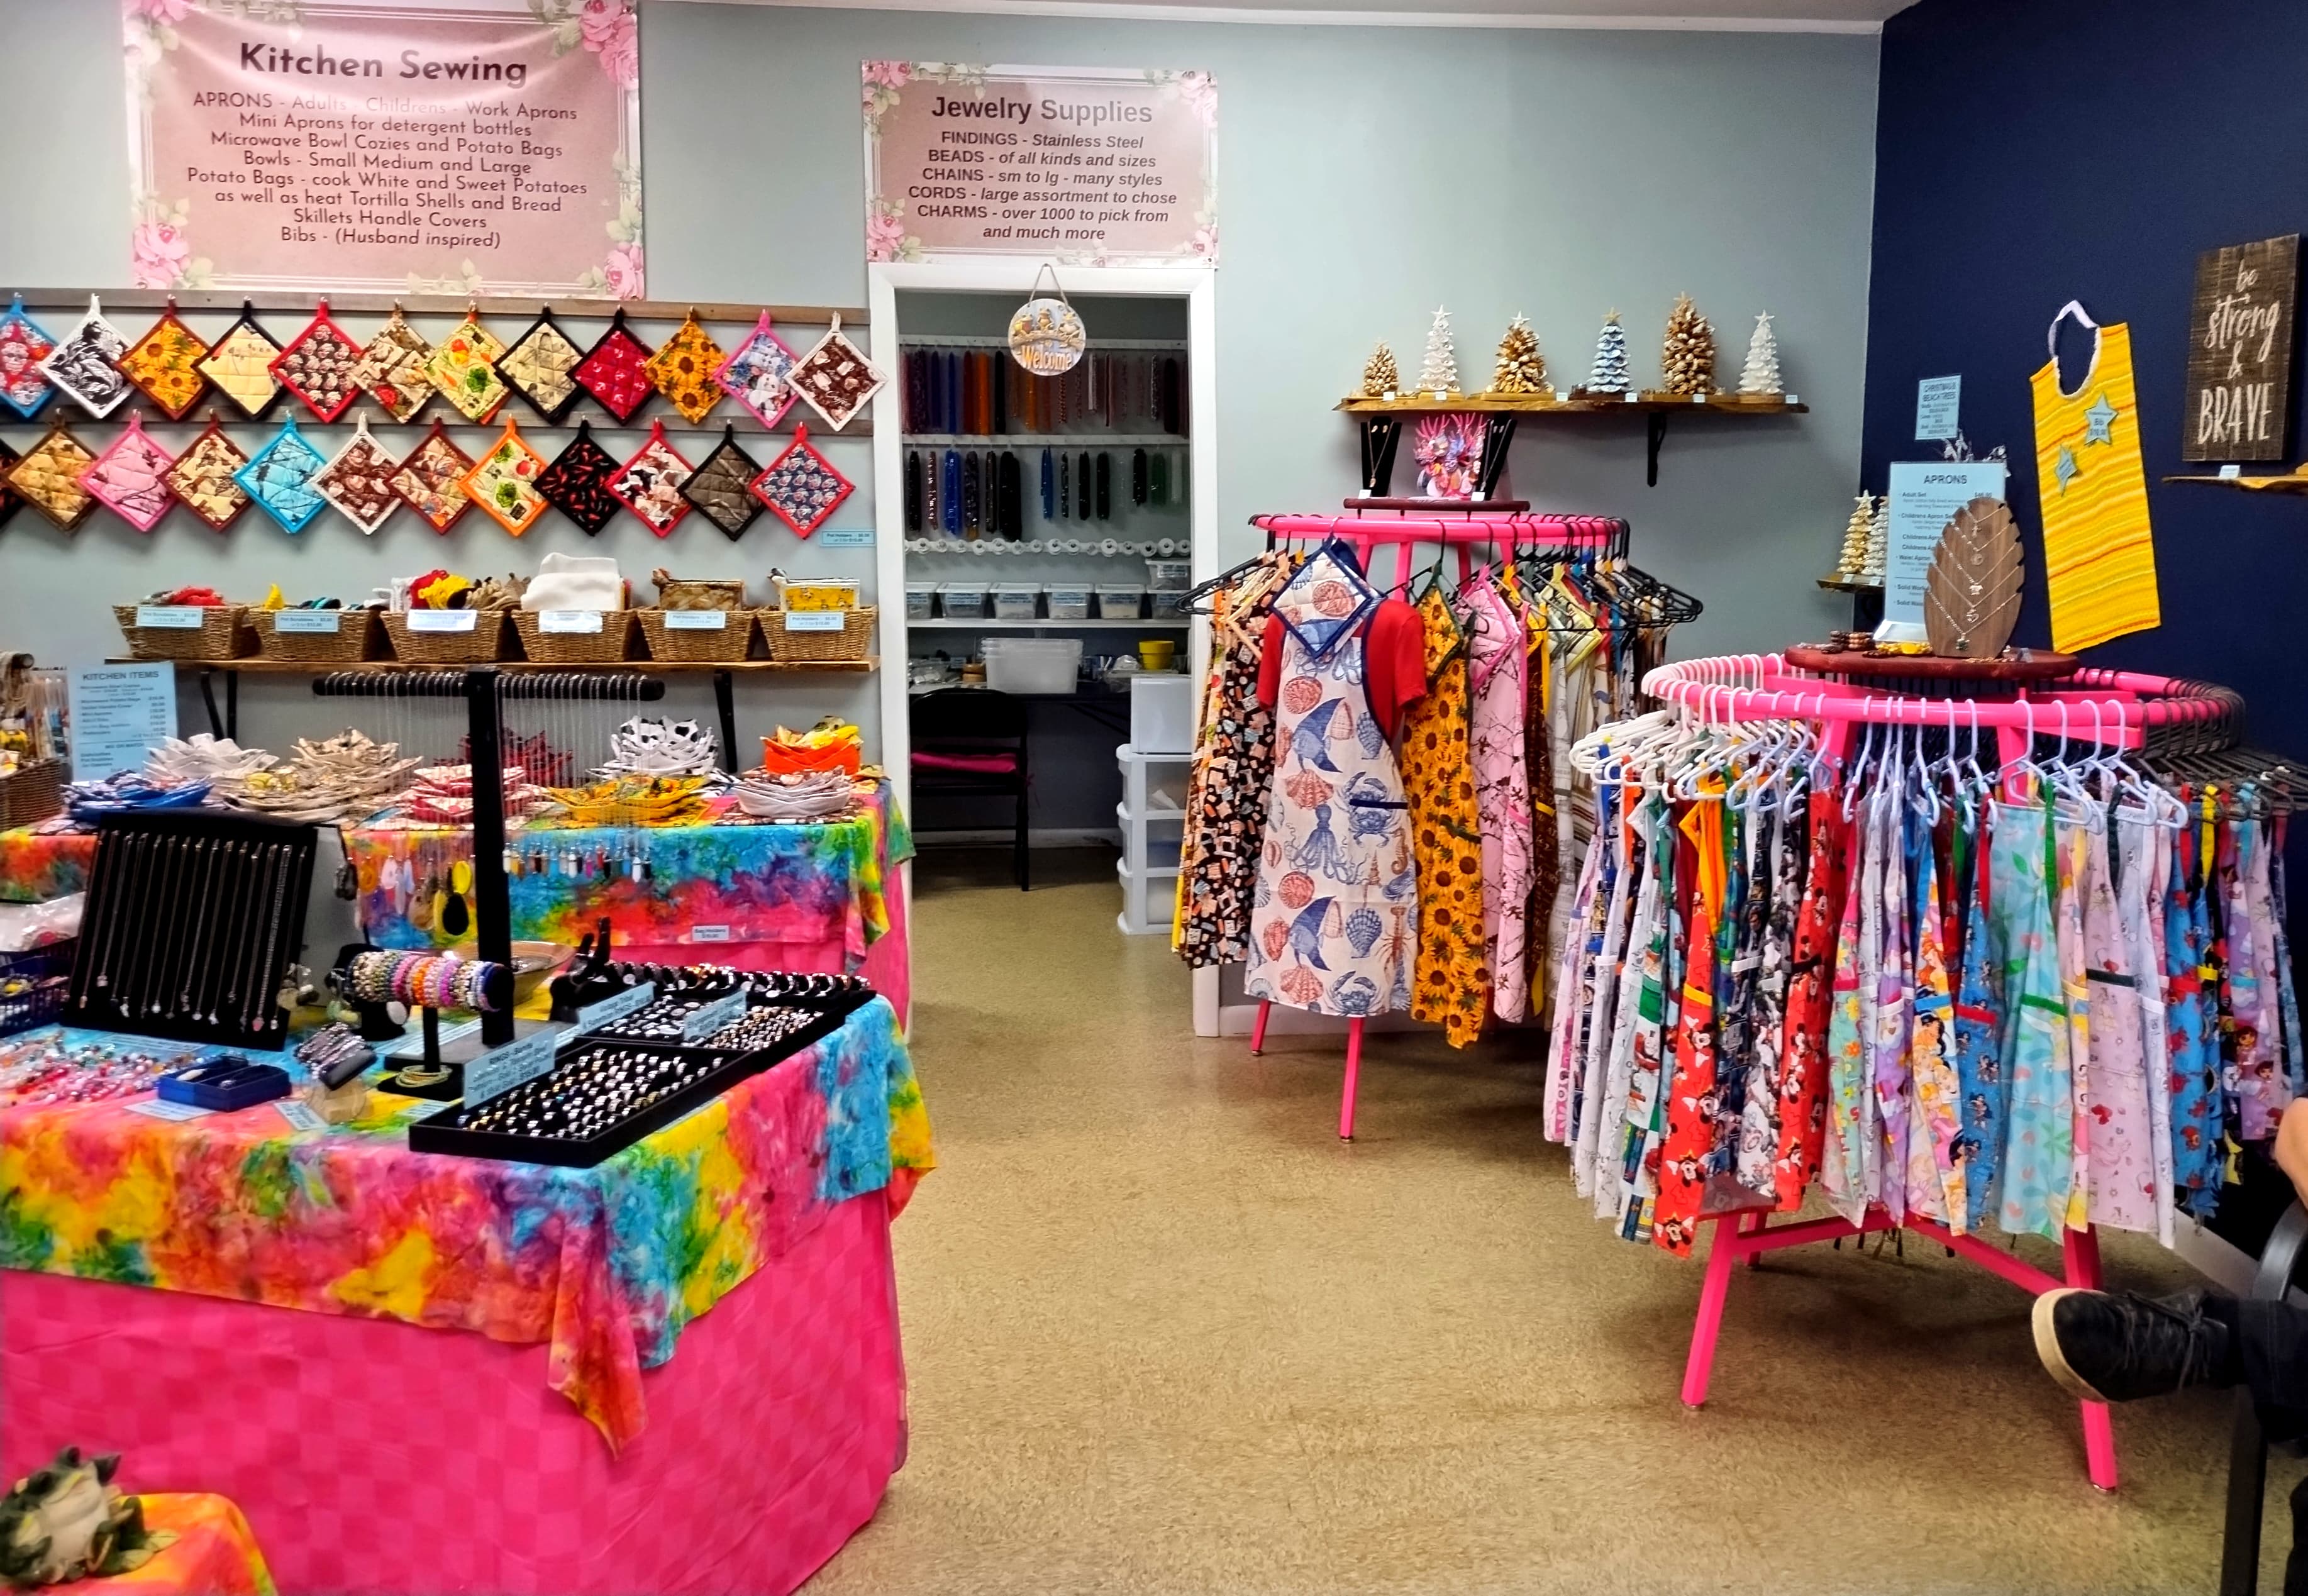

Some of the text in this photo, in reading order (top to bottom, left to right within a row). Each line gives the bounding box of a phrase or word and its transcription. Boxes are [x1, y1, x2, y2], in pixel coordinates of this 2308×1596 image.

[241, 42, 526, 89] Kitchen Sewing
[193, 91, 272, 108] APRONS
[292, 96, 346, 110] Adults
[366, 97, 446, 114] Childrens
[467, 102, 509, 117] Work
[516, 104, 577, 122] Aprons
[932, 97, 1152, 126] Jewelry Supplies
[239, 113, 531, 137] Mini Aprons for detergent bottles
[211, 131, 562, 159] Microwave Bowl Cozies and Potato Bags
[942, 131, 1018, 145] FINDINGS
[1031, 134, 1101, 148] Stainless
[1106, 135, 1144, 149] Steel
[244, 150, 291, 167] Bowls
[309, 153, 356, 169] Small
[363, 155, 433, 171] Medium
[440, 156, 473, 172] and
[480, 158, 531, 177] Large
[928, 149, 984, 163] BEADS
[998, 152, 1016, 164] of
[1018, 152, 1036, 165] all
[1040, 152, 1081, 166] kinds
[1085, 153, 1114, 167] and
[1119, 155, 1156, 168] sizes
[187, 167, 246, 184] Potato
[253, 170, 294, 188] Bags
[312, 172, 351, 187] cook
[358, 173, 409, 189] White
[416, 174, 449, 189] and
[457, 176, 507, 192] Sweet
[513, 177, 587, 195] Potatoes
[923, 167, 984, 181] CHAINS
[998, 172, 1021, 183] sm
[1026, 172, 1041, 184] to
[1045, 171, 1059, 186] lg
[1073, 175, 1114, 187] many
[1119, 173, 1163, 188] styles
[215, 188, 561, 213] as well as heat Tortilla Shells and Bread
[908, 186, 966, 199] CORDS
[980, 188, 1018, 202] large
[1023, 190, 1107, 203] assortment
[1113, 192, 1126, 204] to
[1131, 191, 1177, 204] chose
[294, 209, 487, 228] Skillets Handle Covers
[917, 204, 987, 218] CHARMS
[1002, 209, 1036, 219] over
[1040, 208, 1075, 221] 1000
[1079, 210, 1094, 221] to
[1098, 209, 1130, 224] pick
[1135, 210, 1168, 223] from
[280, 228, 316, 242] Bibs
[335, 228, 418, 246] (Husband
[426, 231, 500, 250] inspired)
[983, 226, 1105, 241] and much more
[2237, 260, 2259, 292] be
[2204, 294, 2280, 362] strong
[1021, 345, 1072, 370] Welcome
[2199, 382, 2273, 445] BRAVE
[1924, 475, 1967, 484] APRONS
[83, 672, 126, 680] KITCHEN
